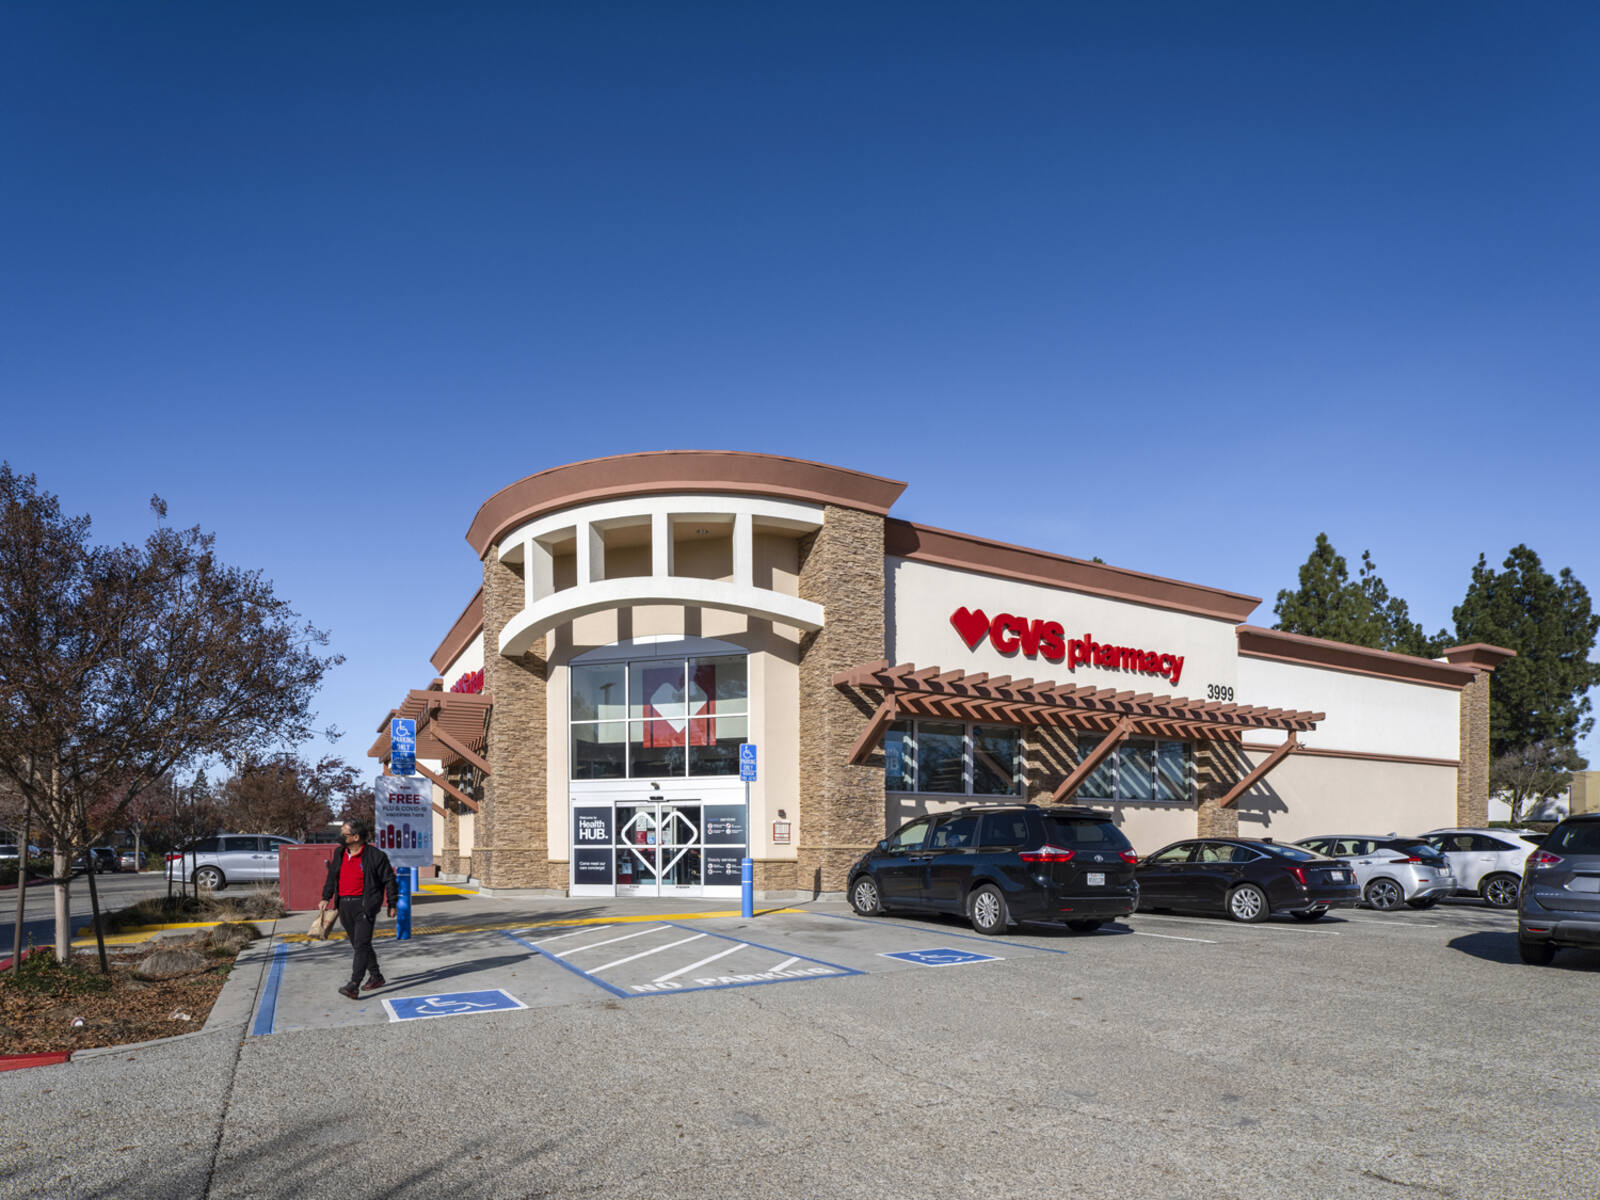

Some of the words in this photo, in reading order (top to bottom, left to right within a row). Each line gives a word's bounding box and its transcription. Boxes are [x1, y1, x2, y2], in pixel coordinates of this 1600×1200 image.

[990, 613, 1066, 661] CVS
[1068, 633, 1185, 685] pharmacy
[1207, 683, 1234, 701] 3999
[389, 793, 421, 805] FREE
[579, 820, 605, 828] Health
[579, 828, 609, 840] HUB.
[630, 981, 683, 993] NO
[694, 967, 835, 986] PARKING
